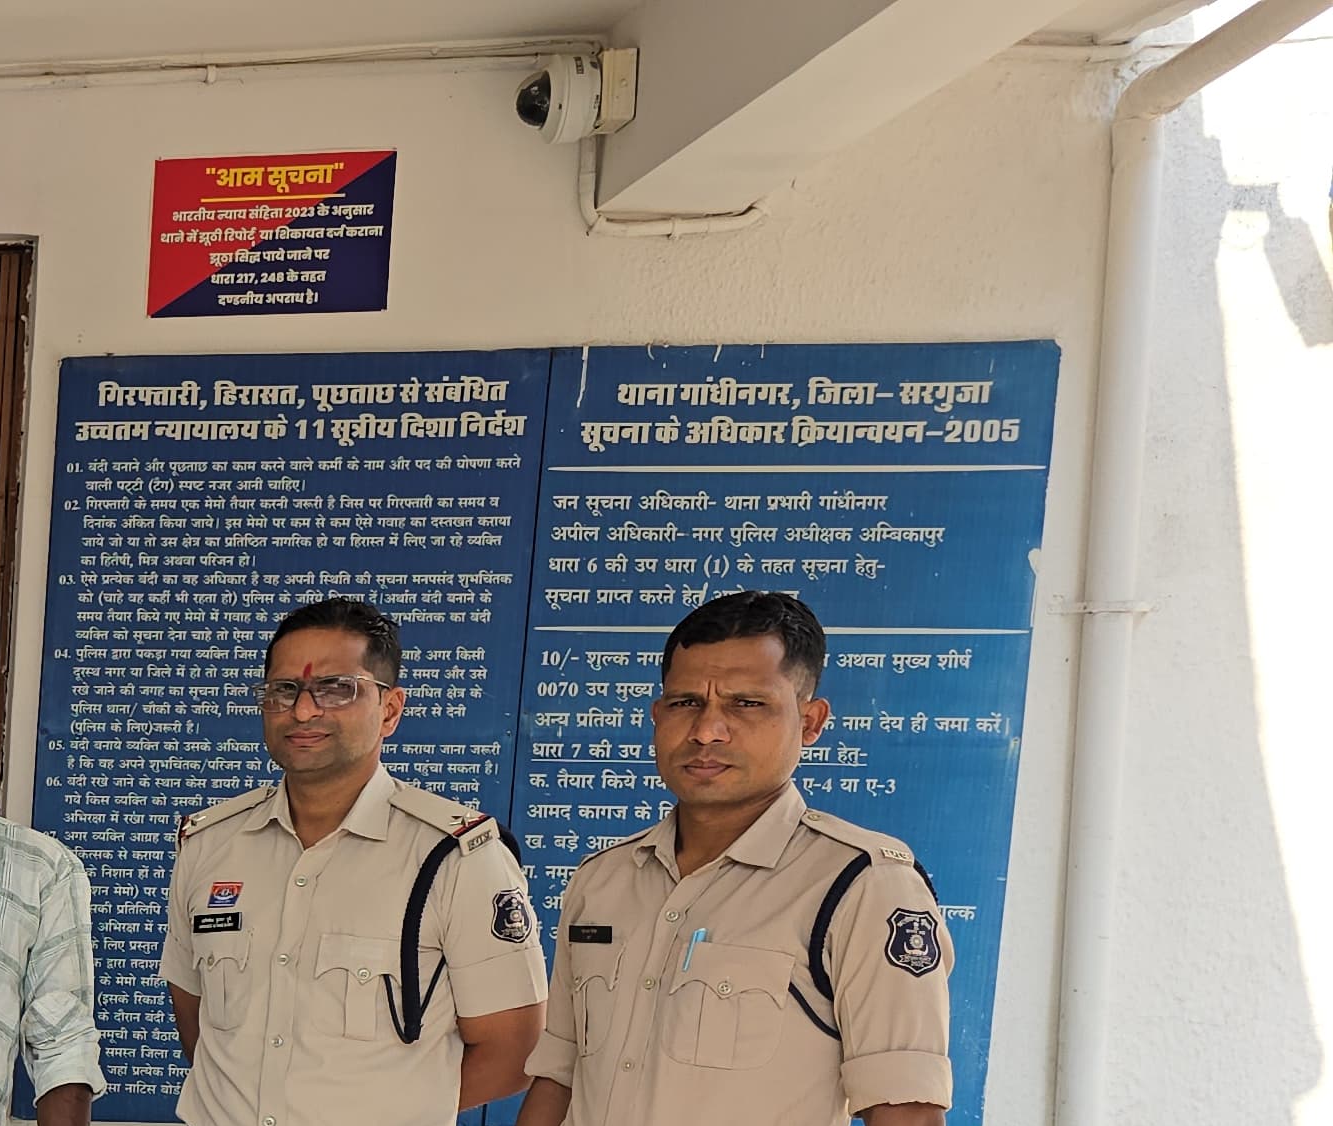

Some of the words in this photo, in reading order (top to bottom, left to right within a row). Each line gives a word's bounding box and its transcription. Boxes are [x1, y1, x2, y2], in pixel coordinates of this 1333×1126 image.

[173, 207, 216, 221] भारतीय
[217, 209, 247, 220] न्याय
[249, 205, 283, 220] संहिता
[285, 207, 315, 217] 2023
[317, 203, 330, 216] के
[332, 204, 374, 220] अनुसार
[161, 230, 184, 243] थाने
[186, 229, 199, 242] में
[199, 228, 222, 246] झूठी
[259, 230, 274, 240] या
[275, 226, 325, 239] शिकायत
[326, 224, 345, 238] दर्ज
[346, 225, 384, 237] कराना
[209, 253, 233, 267] झूठा
[235, 249, 261, 263] सिद्ध
[262, 248, 285, 261] पाये
[287, 247, 312, 260] जाने
[314, 249, 330, 259] पर
[210, 273, 235, 285] धारा
[236, 272, 259, 285] 217,
[286, 269, 299, 282] के
[300, 271, 326, 282] तहत
[99, 381, 207, 410] गिरफ्तारी,
[214, 380, 305, 409] हिरासत,
[312, 384, 397, 412] पूछताछ
[399, 377, 422, 403] से
[425, 376, 509, 402] संबंधित
[618, 384, 677, 405] थाना
[680, 376, 800, 410] गांधीनगर,
[899, 381, 993, 412] सरगुजा
[75, 421, 152, 441] उच्चतम
[154, 419, 262, 440] न्यायालय
[263, 414, 288, 440] के
[295, 419, 324, 439] 11
[331, 413, 397, 446] सूत्रीय
[401, 413, 457, 438] दिशा
[460, 409, 527, 437] निर्देश
[581, 423, 652, 452] सूचना
[655, 415, 681, 443] के
[685, 416, 788, 443] अधिकार
[553, 496, 579, 509] जन
[586, 496, 632, 516] सूचना
[725, 496, 761, 510] थाना
[767, 491, 813, 510] प्रभारी
[819, 491, 888, 510] गांधीनगर
[551, 522, 600, 541] अपील
[692, 528, 724, 542] नगर
[730, 521, 778, 547] पुलिस
[784, 522, 853, 544] अधीक्षक
[859, 521, 945, 547] अम्बिकापुर
[549, 558, 580, 572] धारा
[587, 558, 597, 573] 6
[605, 553, 628, 572] की
[635, 559, 658, 572] उप
[665, 559, 697, 573] धारा
[704, 555, 729, 578] (1)
[736, 553, 755, 573] के
[761, 559, 796, 575] तहत
[802, 559, 849, 580] सूचना
[545, 589, 590, 610] सूचना
[597, 590, 633, 603] प्राप्त
[639, 584, 676, 604] करने
[585, 652, 631, 670] शुल्क
[836, 654, 886, 668] अथवा
[892, 654, 932, 673] मुख्य
[936, 649, 972, 670] शीर्ष
[537, 682, 578, 696] 0070
[586, 683, 610, 696] उप
[615, 683, 654, 702] मुख्य
[535, 713, 570, 726] अन्य
[576, 707, 624, 727] प्रतियों
[630, 708, 644, 728] में
[842, 717, 873, 730] नाम
[879, 711, 905, 732] देय
[910, 712, 928, 733] ही
[934, 718, 970, 732] जमा
[533, 743, 564, 757] धारा
[572, 744, 581, 758] 7
[589, 739, 612, 758] की
[618, 745, 642, 758] उप
